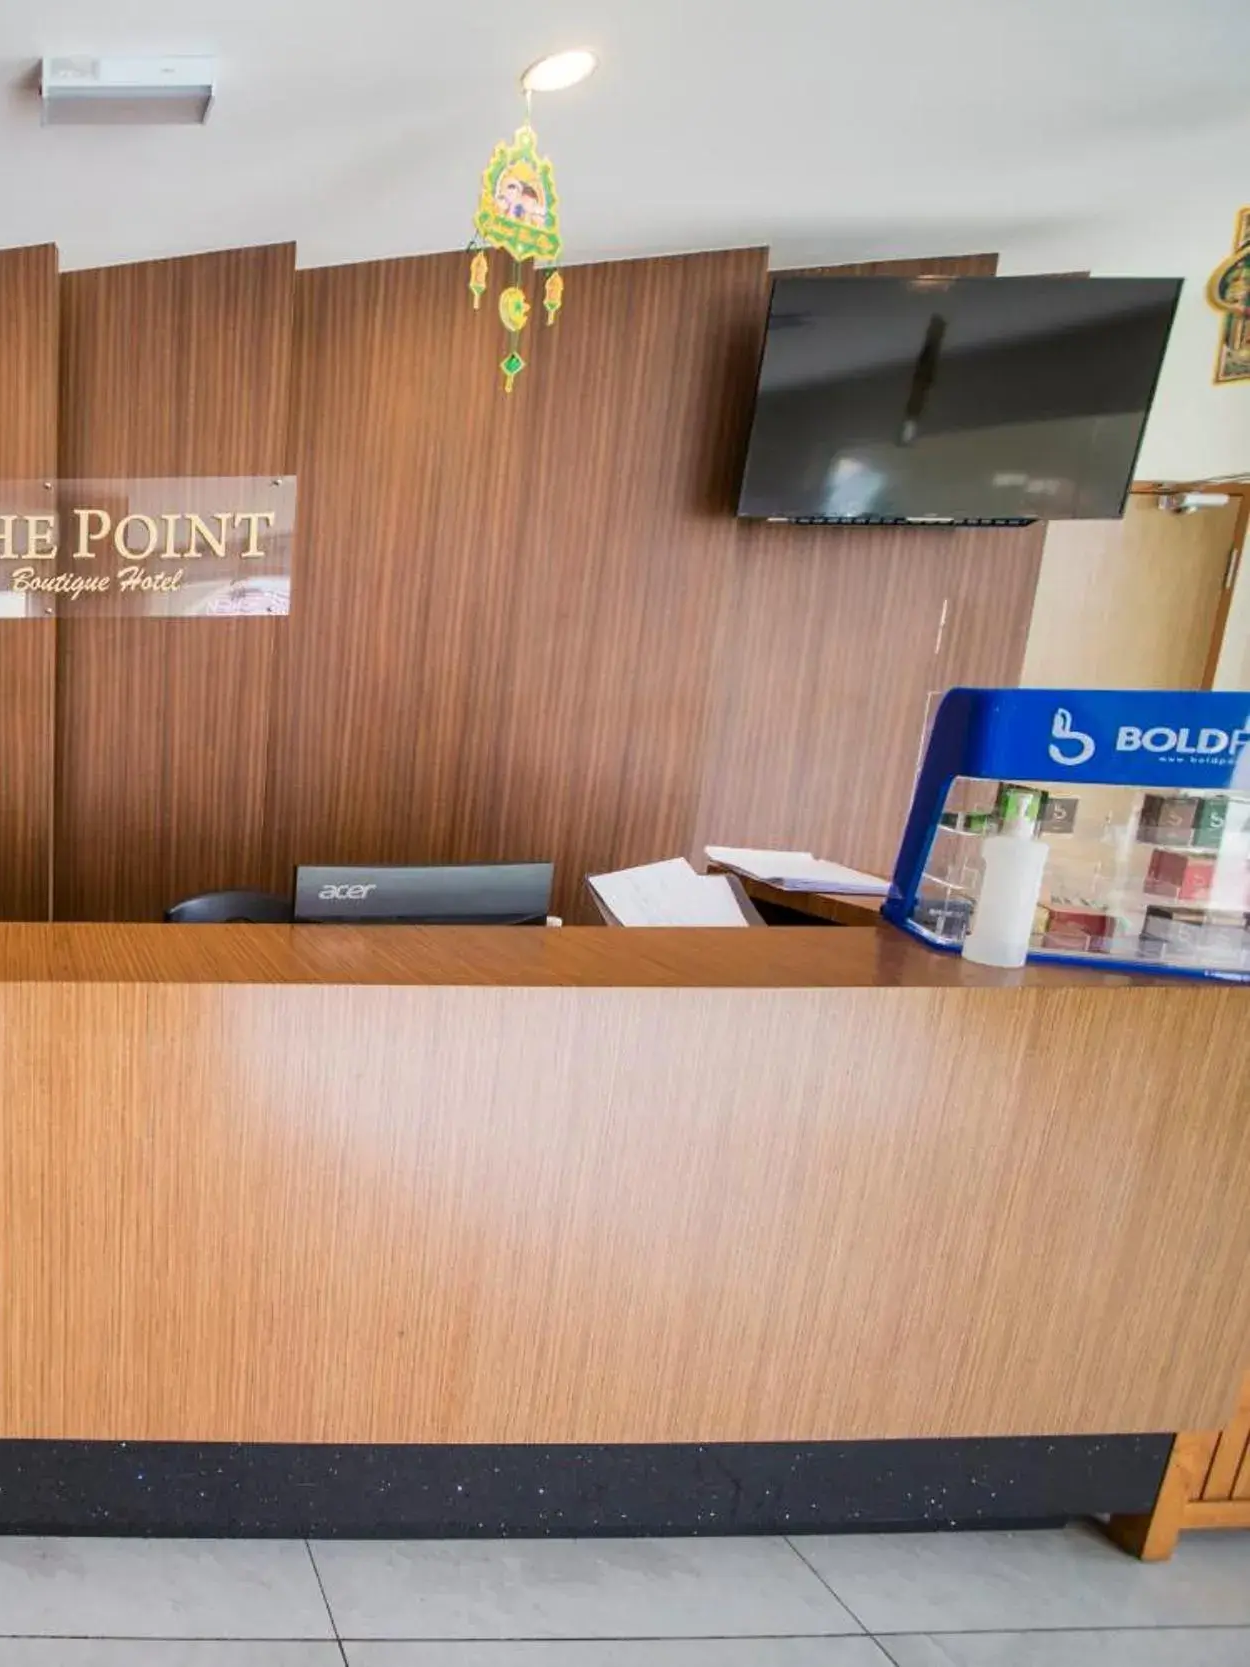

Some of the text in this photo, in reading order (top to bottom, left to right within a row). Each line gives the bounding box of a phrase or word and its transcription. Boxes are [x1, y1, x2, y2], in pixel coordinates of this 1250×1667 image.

[72, 509, 275, 561] POINT
[11, 566, 184, 600] Boutique Hotel
[318, 884, 377, 900] acer
